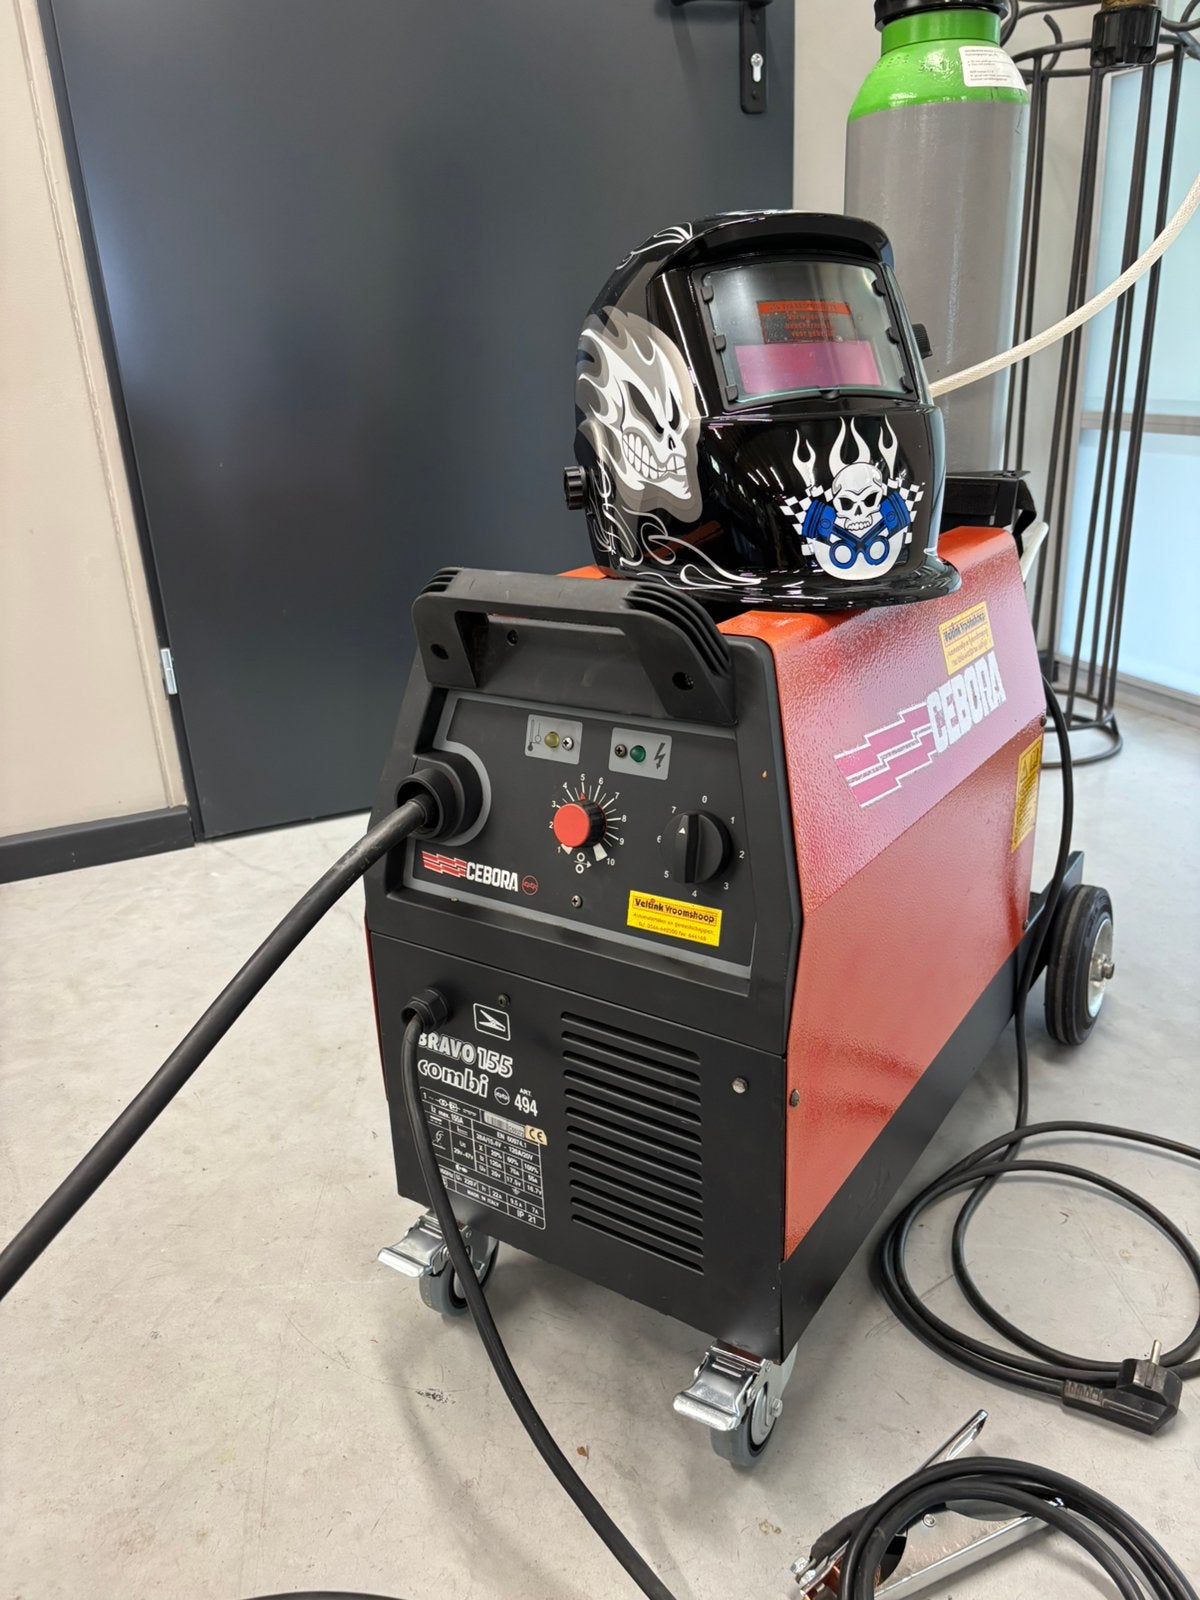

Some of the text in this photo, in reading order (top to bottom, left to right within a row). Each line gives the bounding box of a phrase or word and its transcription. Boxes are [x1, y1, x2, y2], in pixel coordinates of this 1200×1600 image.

[926, 650, 1007, 753] CEBORA
[580, 773, 585, 781] 5
[599, 777, 604, 785] 6
[615, 791, 620, 799] 7
[701, 795, 708, 804] 0
[552, 800, 556, 808] 3
[671, 805, 677, 814] 7
[621, 814, 627, 822] 8
[548, 821, 554, 829] 2
[739, 850, 745, 859] 2
[607, 857, 615, 866] 10
[466, 861, 519, 892] CEBORA
[663, 870, 670, 878] 5
[723, 882, 729, 890] 3
[691, 890, 697, 898] 4
[635, 898, 715, 923] Veltink Vroomshoop
[477, 1046, 513, 1078] 155
[417, 1059, 489, 1098] combi
[514, 1094, 538, 1117] 494
[529, 1128, 543, 1142] CE
[528, 1214, 537, 1224] 21
